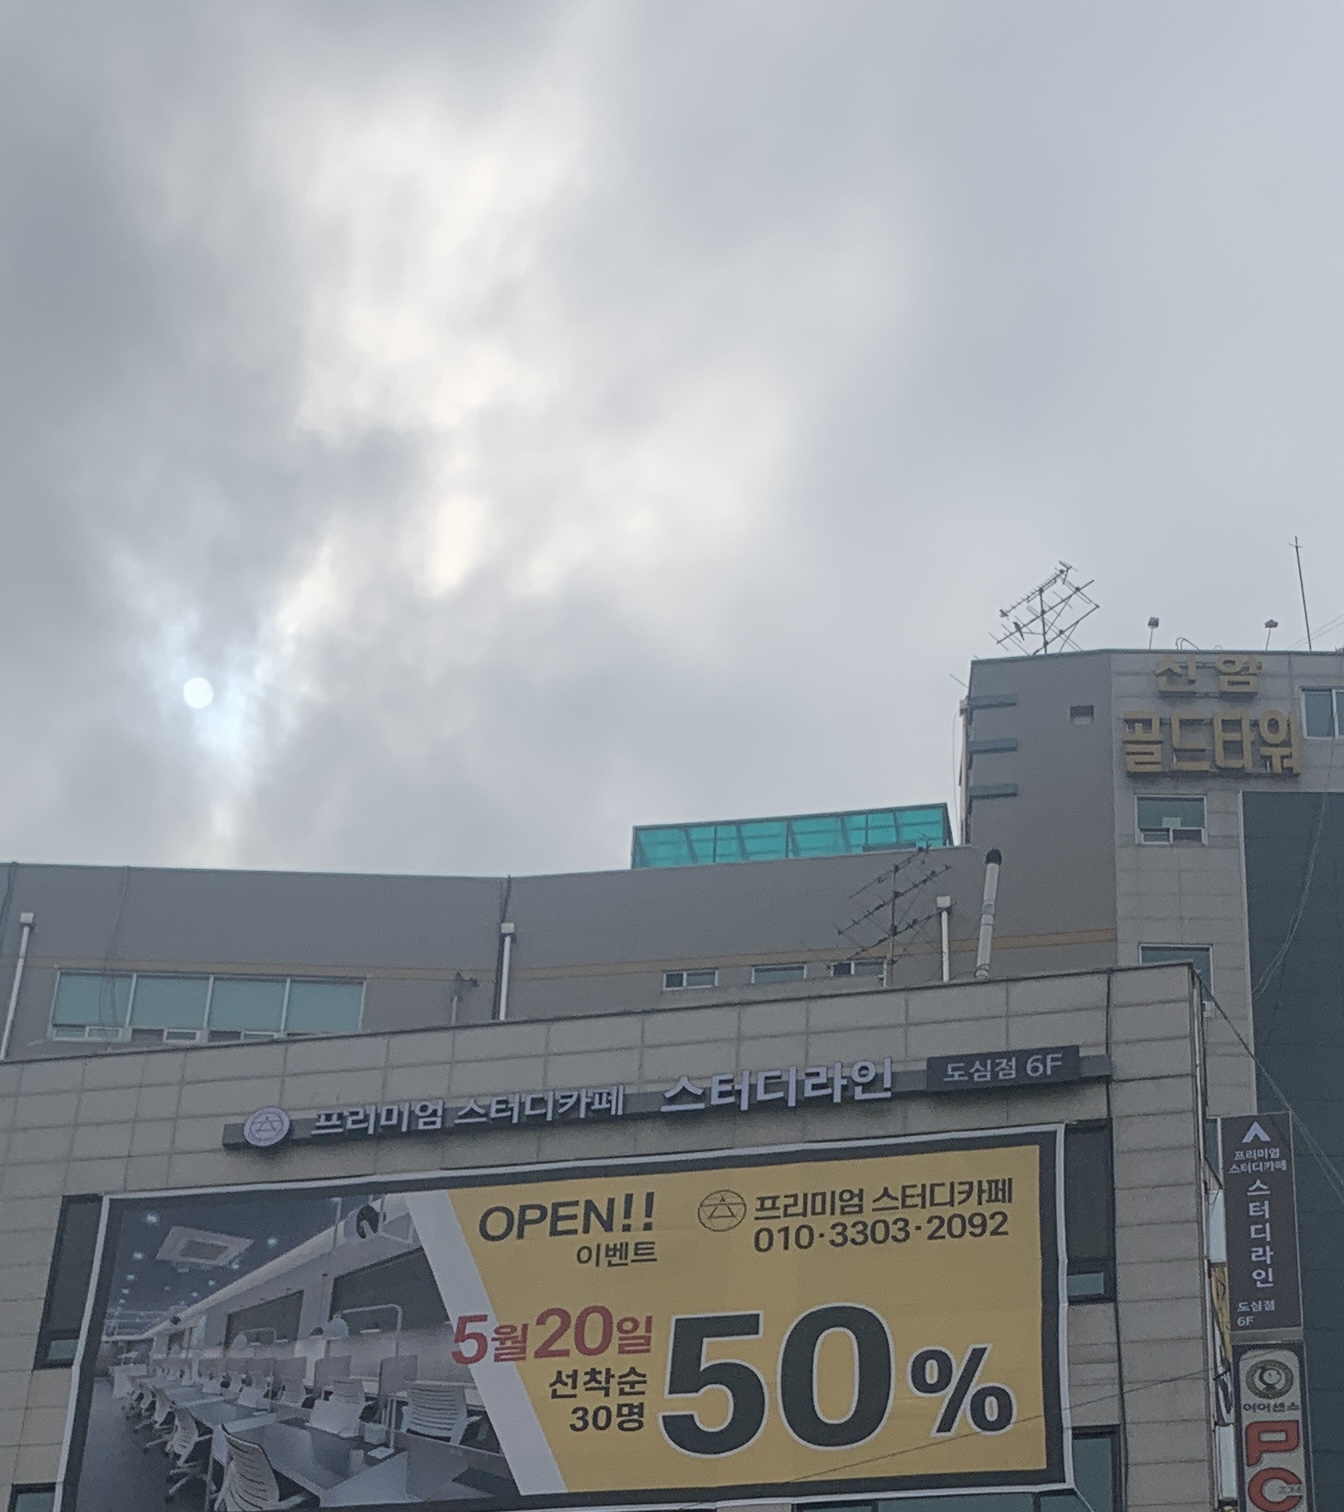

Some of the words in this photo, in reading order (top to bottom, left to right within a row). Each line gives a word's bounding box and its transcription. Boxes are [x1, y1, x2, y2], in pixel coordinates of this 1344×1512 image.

[1122, 708, 1302, 776] 골드타워
[311, 1099, 444, 1136] 프리미엄
[454, 1084, 625, 1125] 스터디카페
[660, 1057, 893, 1113] 스터디라인
[943, 1055, 1017, 1083] 도심점
[1026, 1052, 1063, 1079] 6F
[478, 1191, 655, 1243] OPEN!!
[754, 1187, 864, 1222] 프리미엄
[872, 1177, 1014, 1213] 스터디카페
[576, 1242, 658, 1268] 이벤트
[1246, 1179, 1274, 1288] 스터디라인
[1237, 1315, 1255, 1327] 6F
[548, 1366, 648, 1401] 선착순
[658, 1302, 1017, 1459] 50%
[568, 1401, 645, 1433] 30명
